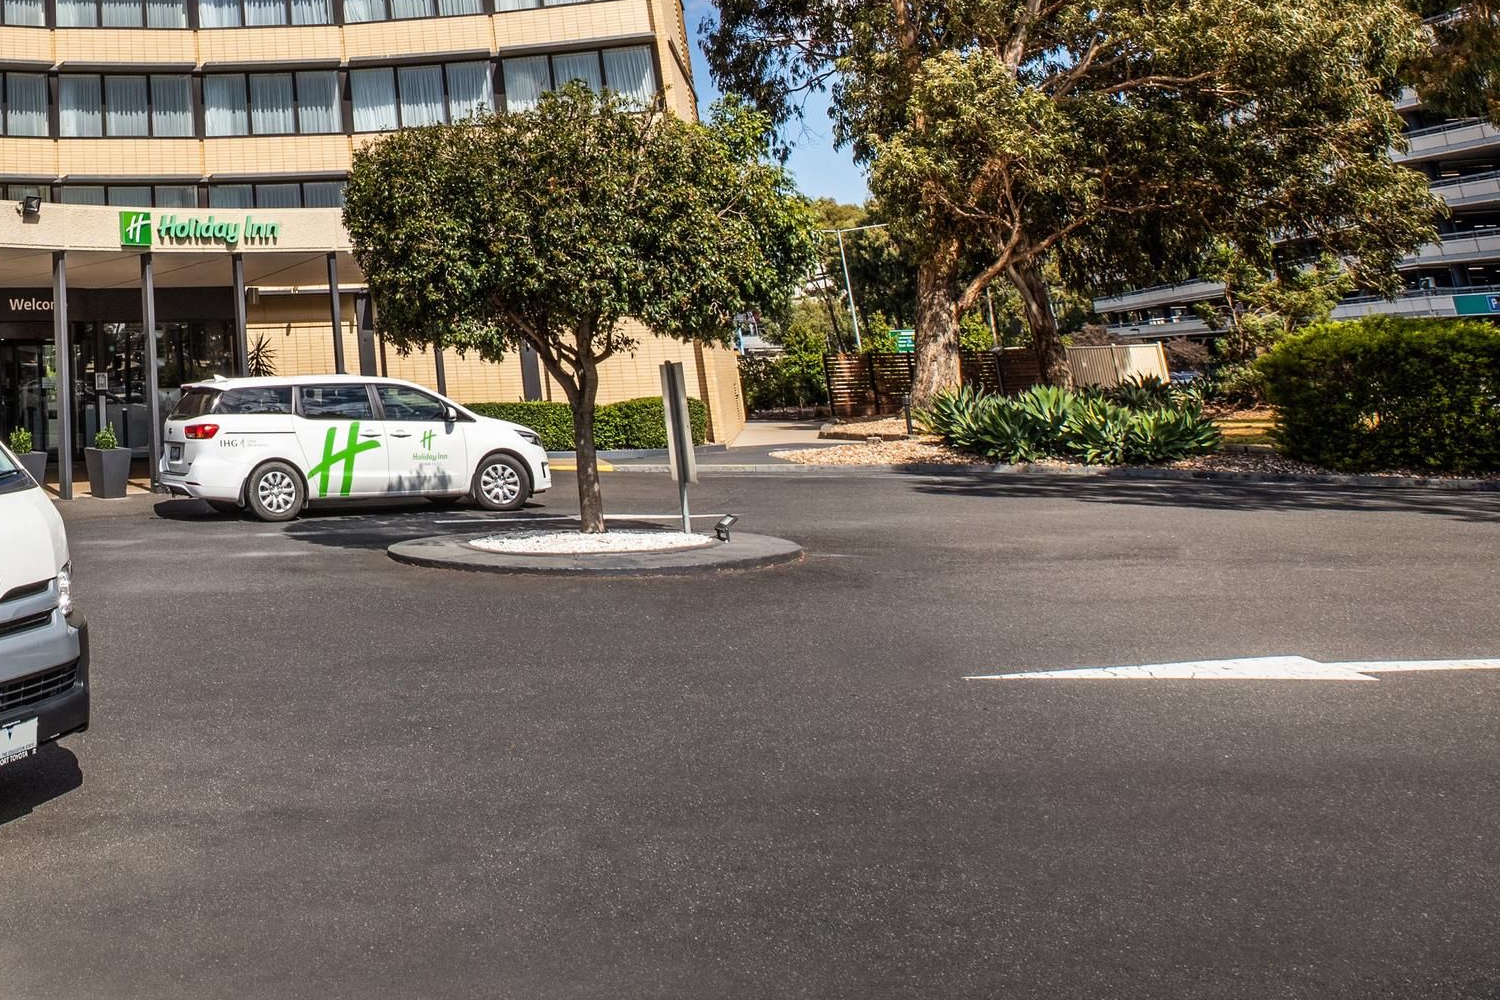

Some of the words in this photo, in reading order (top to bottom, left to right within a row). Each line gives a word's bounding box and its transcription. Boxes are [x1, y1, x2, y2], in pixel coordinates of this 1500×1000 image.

[157, 214, 241, 243] Holiday
[243, 214, 280, 239] Inn
[9, 297, 68, 311] Welco
[219, 439, 238, 448] IHG
[412, 452, 437, 461] Holiday
[437, 452, 448, 460] Inn
[10, 750, 28, 762] TOYOTA
